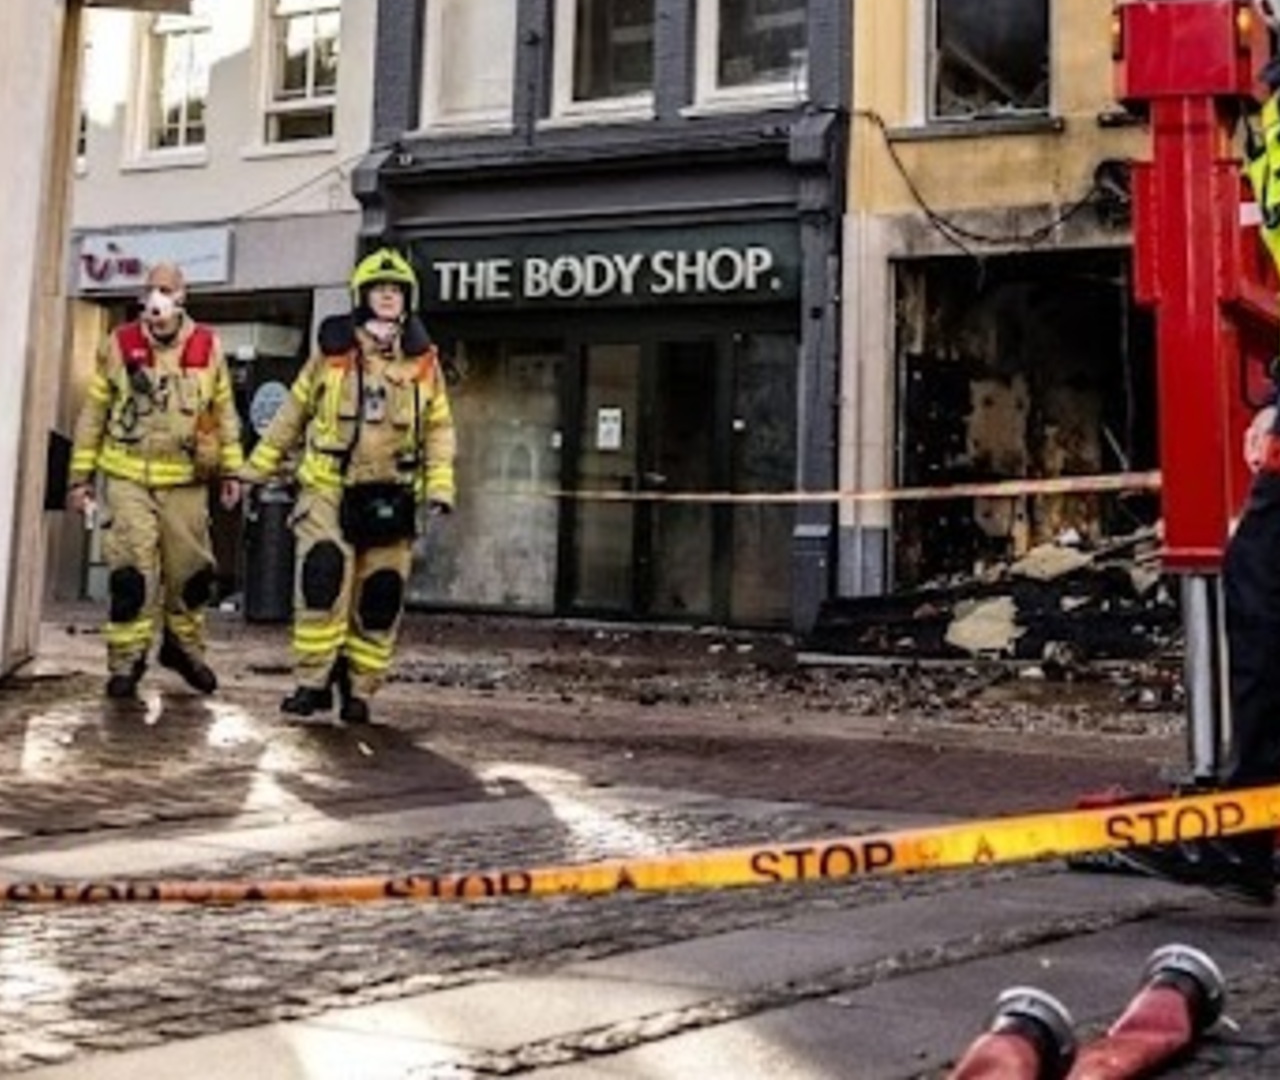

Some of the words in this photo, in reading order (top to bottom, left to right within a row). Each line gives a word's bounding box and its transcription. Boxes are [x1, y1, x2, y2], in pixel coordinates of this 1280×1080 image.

[433, 260, 512, 300] THE
[523, 254, 643, 297] BODY
[650, 247, 782, 294] SHOP.
[750, 839, 895, 884] STOP
[1106, 801, 1245, 846] STOP
